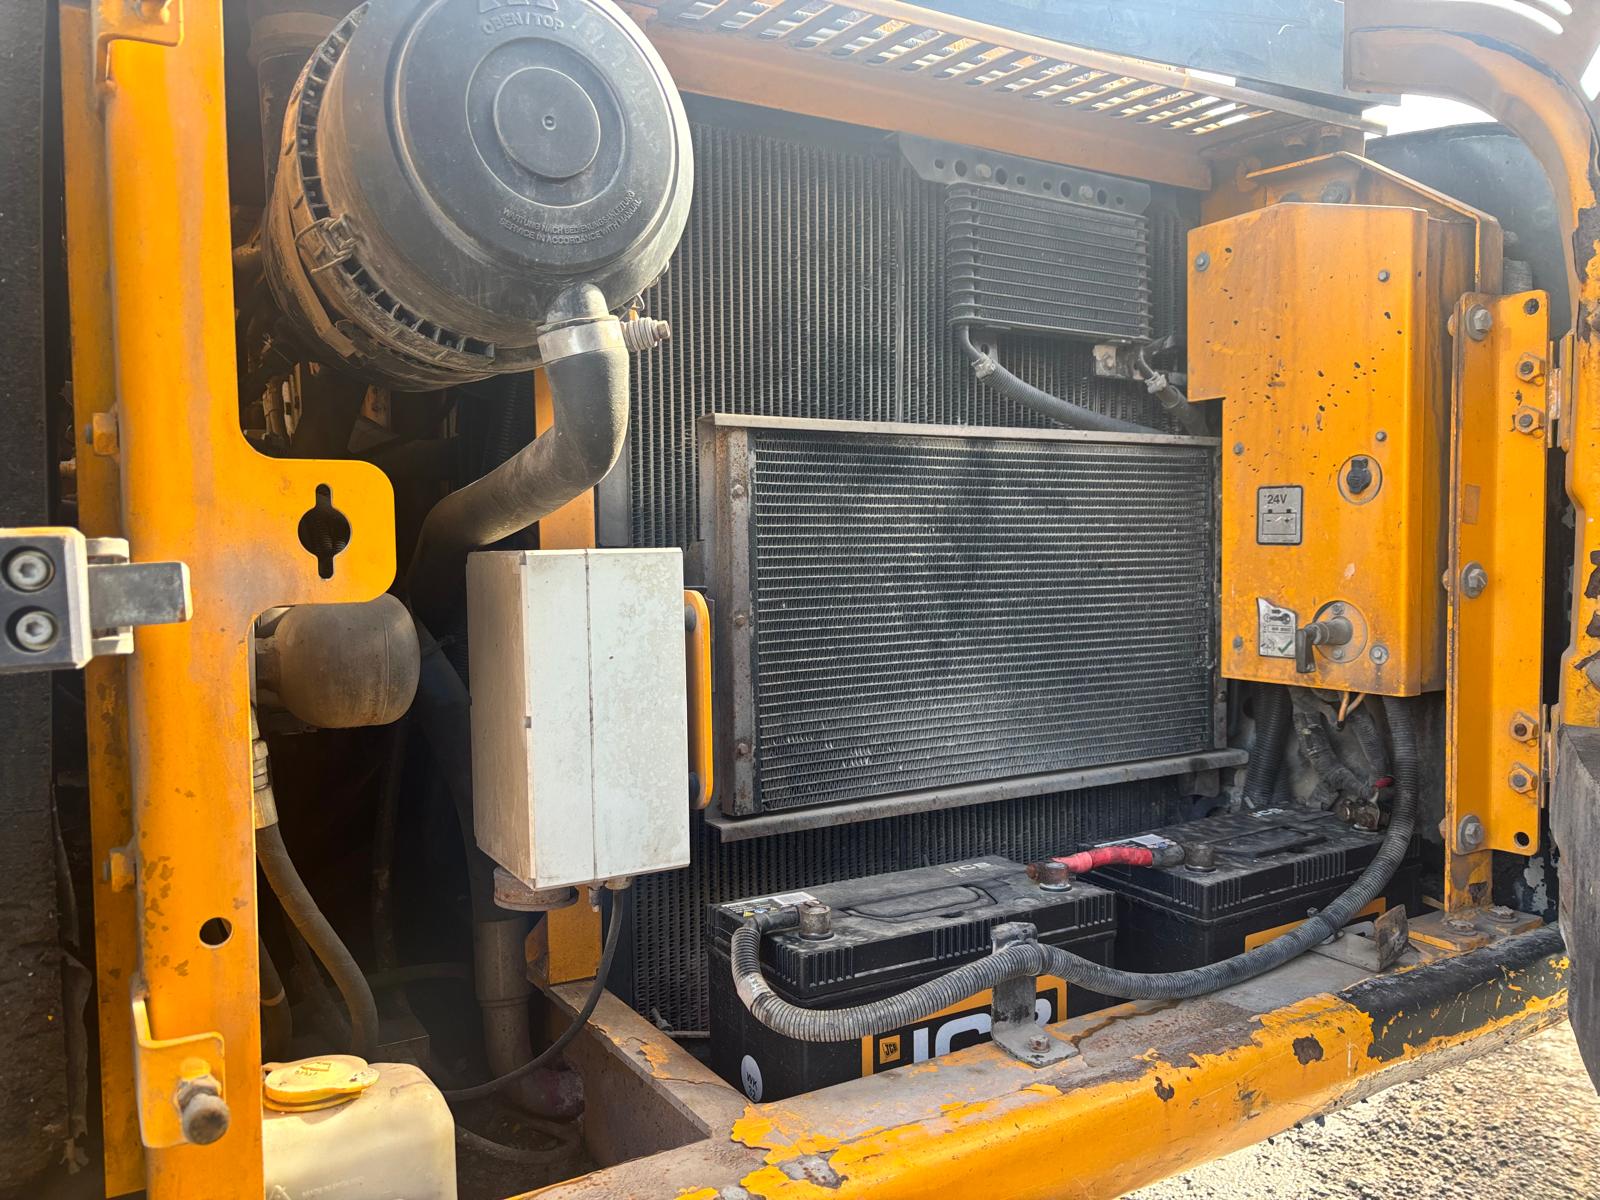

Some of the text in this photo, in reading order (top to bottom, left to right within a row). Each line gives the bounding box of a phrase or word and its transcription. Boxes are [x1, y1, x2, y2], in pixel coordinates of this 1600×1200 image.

[482, 12, 524, 35] OBEN
[531, 12, 565, 33] TOP
[499, 216, 536, 241] SERVICE
[546, 230, 603, 246] ACCORDANCE
[1267, 494, 1288, 505] 24V
[746, 1071, 758, 1091] WK
